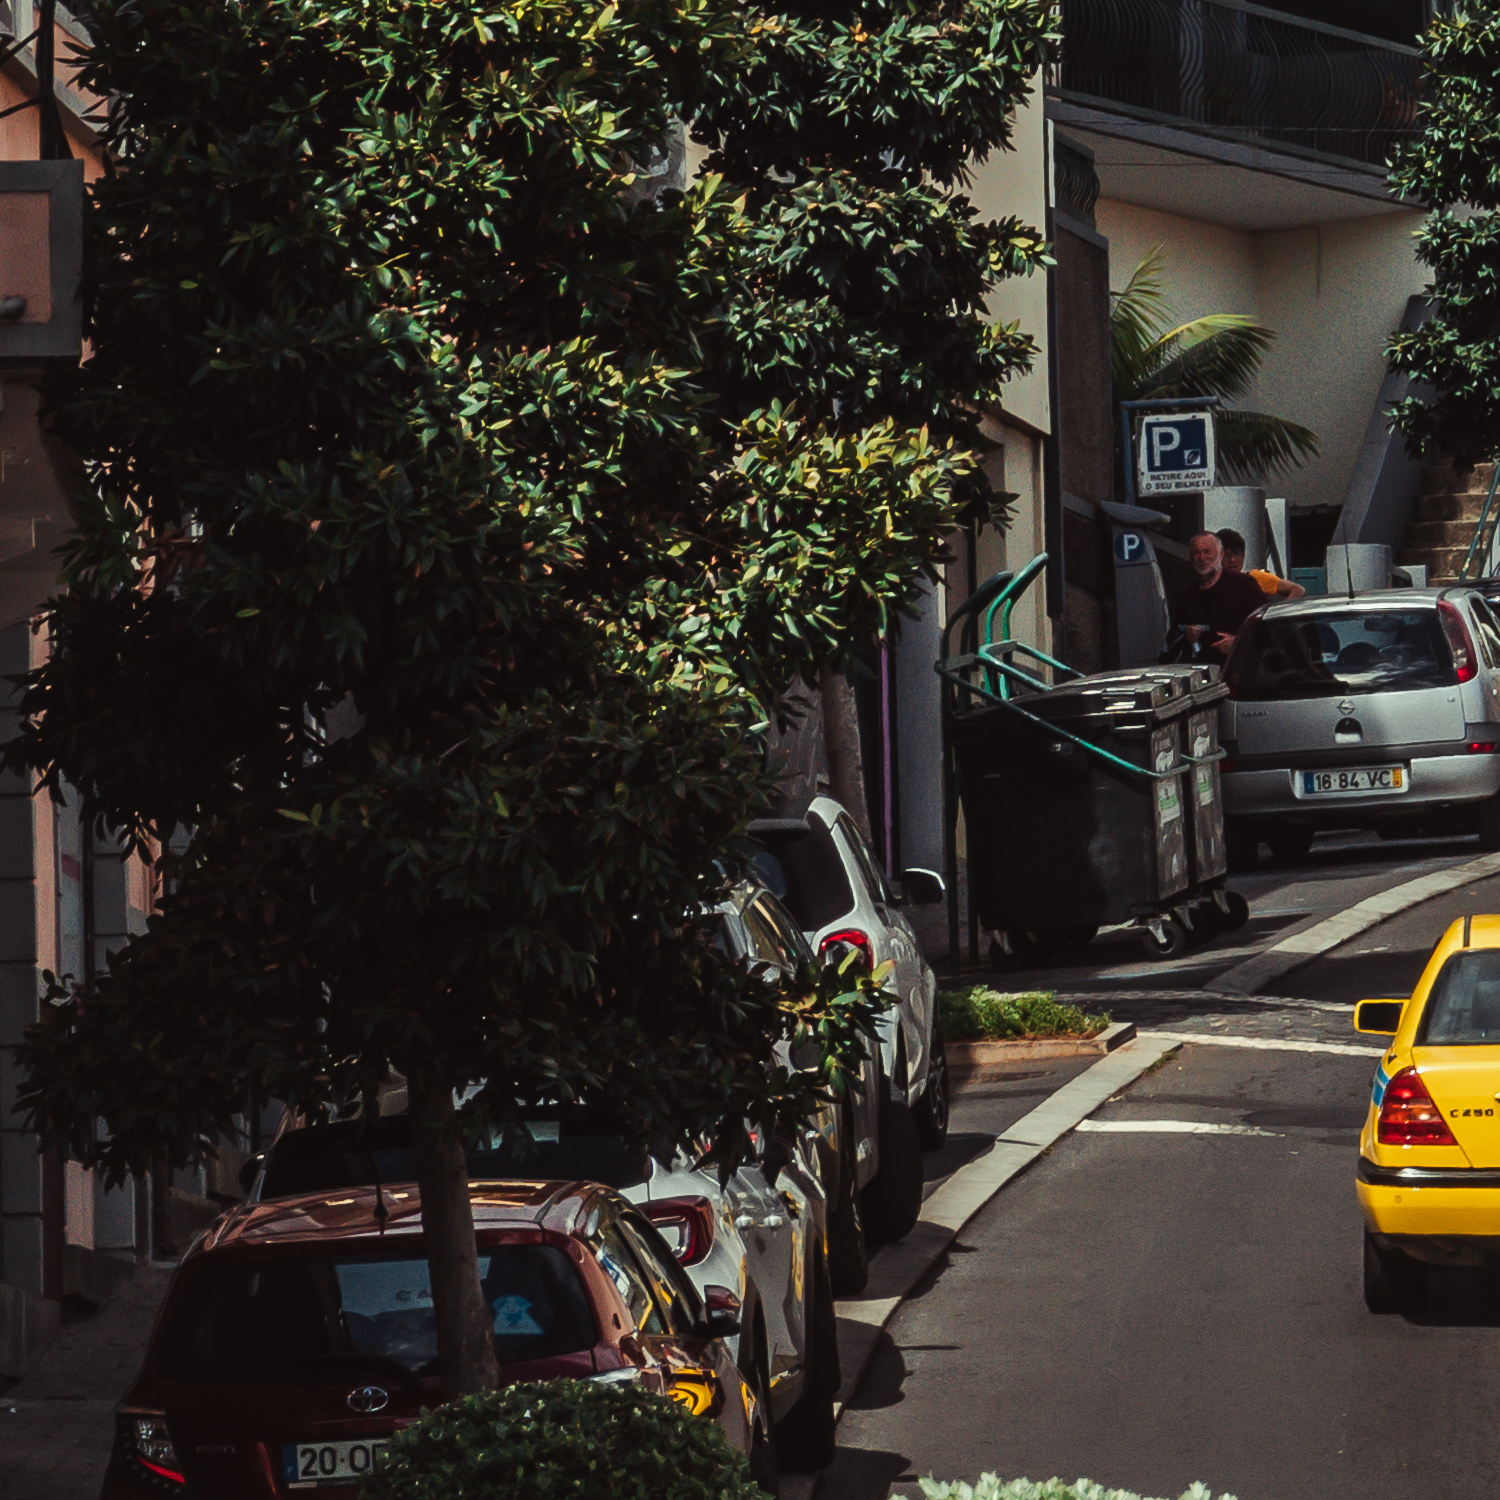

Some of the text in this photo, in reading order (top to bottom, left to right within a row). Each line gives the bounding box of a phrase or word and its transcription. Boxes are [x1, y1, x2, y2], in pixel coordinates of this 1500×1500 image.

[1152, 426, 1180, 467] P
[1155, 482, 1172, 490] SEU
[1124, 534, 1139, 560] P
